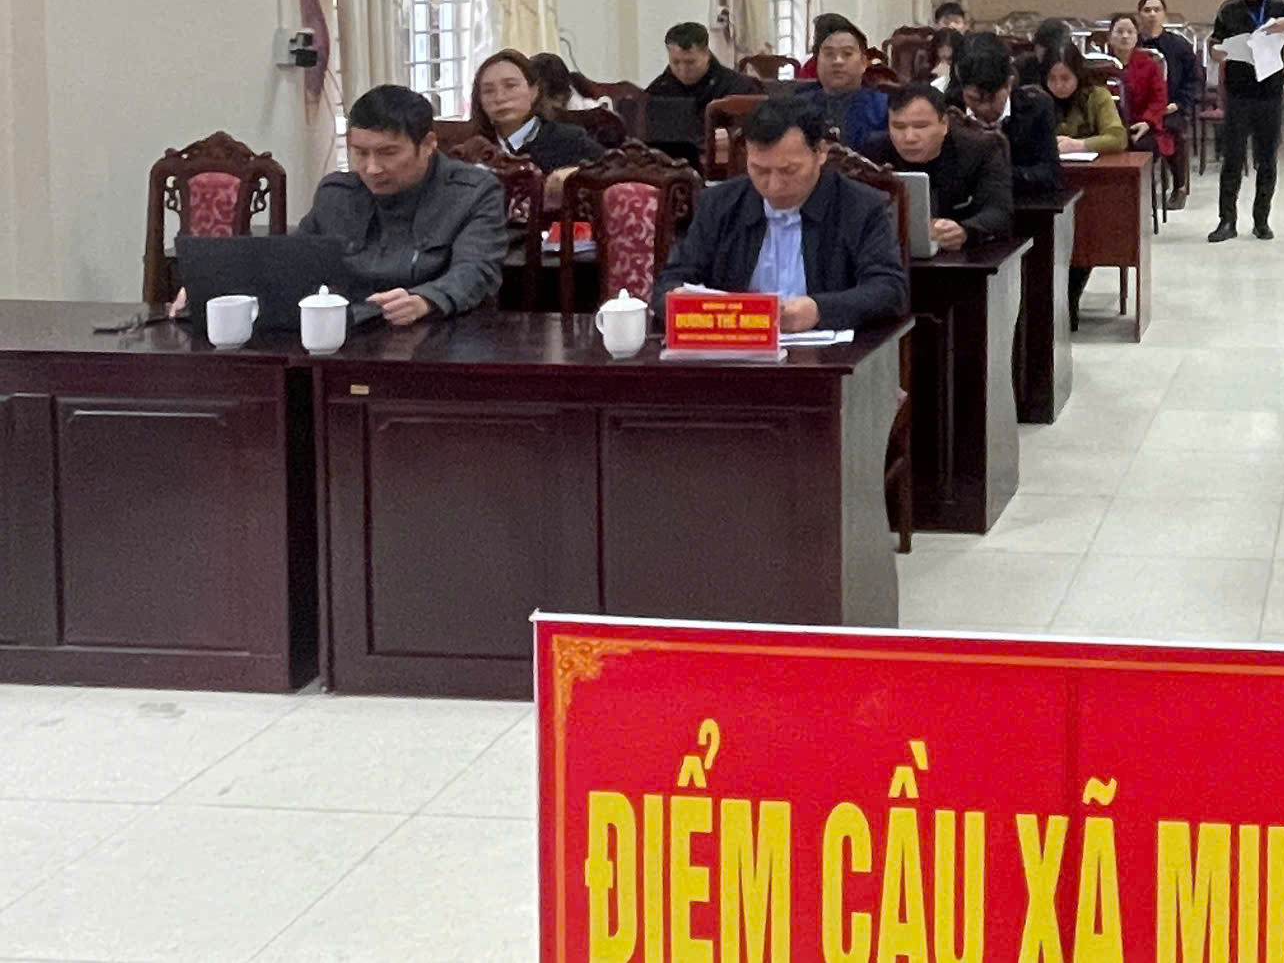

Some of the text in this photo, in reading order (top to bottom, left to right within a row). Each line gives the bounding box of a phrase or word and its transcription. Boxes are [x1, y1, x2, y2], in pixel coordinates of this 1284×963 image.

[585, 718, 791, 963] ĐIỂM
[822, 740, 985, 963] CẦU
[1016, 777, 1124, 963] XÃ
